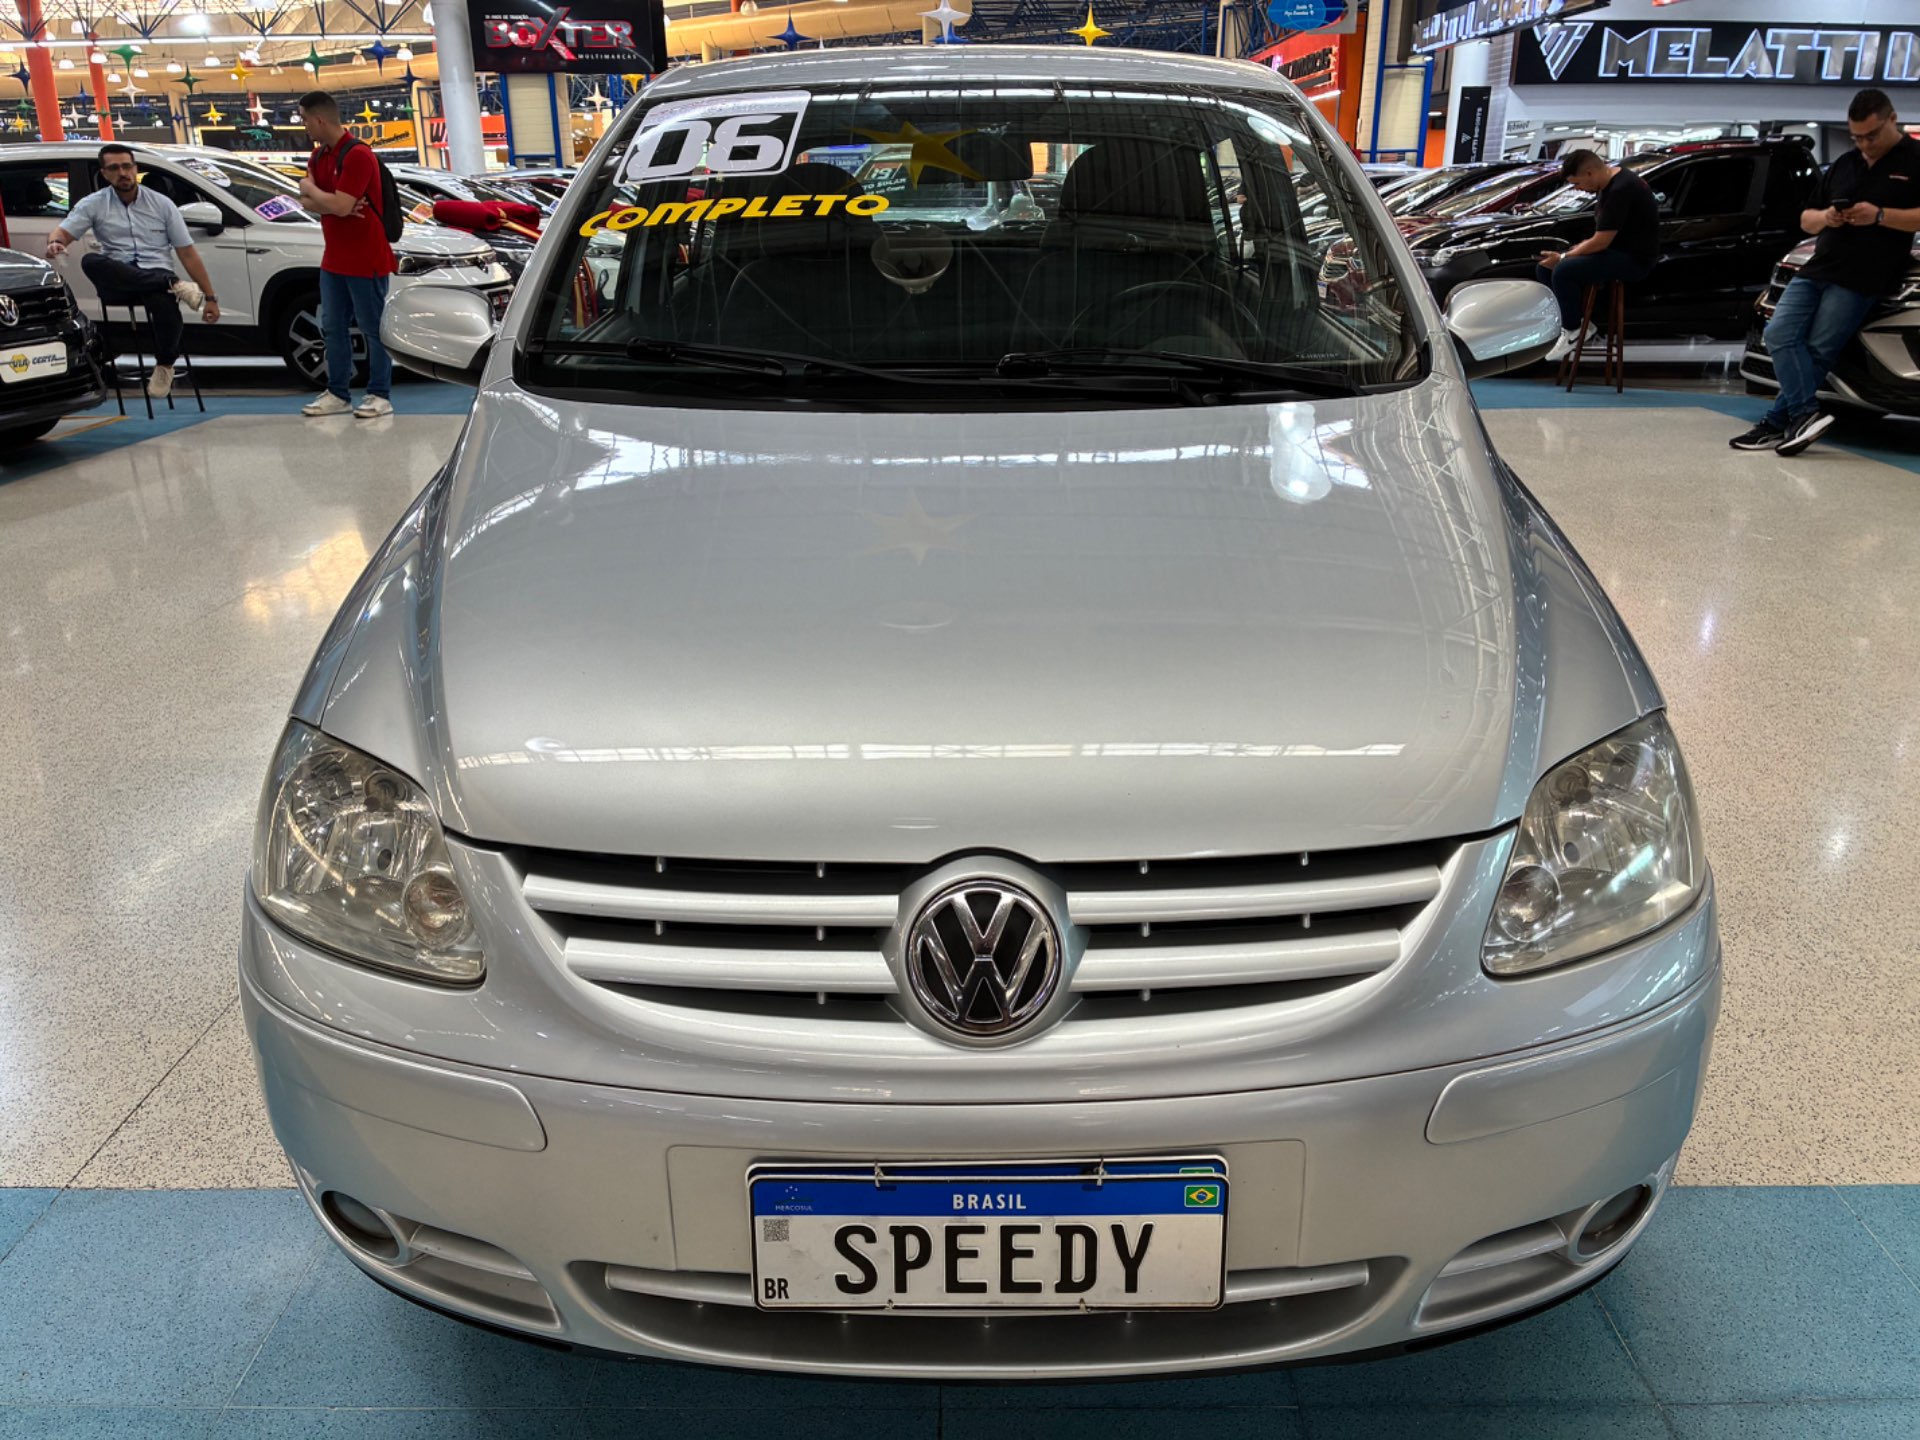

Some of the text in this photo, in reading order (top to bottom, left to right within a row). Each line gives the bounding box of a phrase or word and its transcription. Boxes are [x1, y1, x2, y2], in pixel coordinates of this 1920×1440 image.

[484, 6, 637, 61] BOXTER
[1598, 27, 1881, 80] MELATTI
[626, 113, 785, 181] 06
[579, 194, 890, 238] COMPLETO
[953, 1193, 1027, 1211] BRASIL
[833, 1224, 1155, 1295] SPEEDY
[764, 1278, 790, 1299] BR
